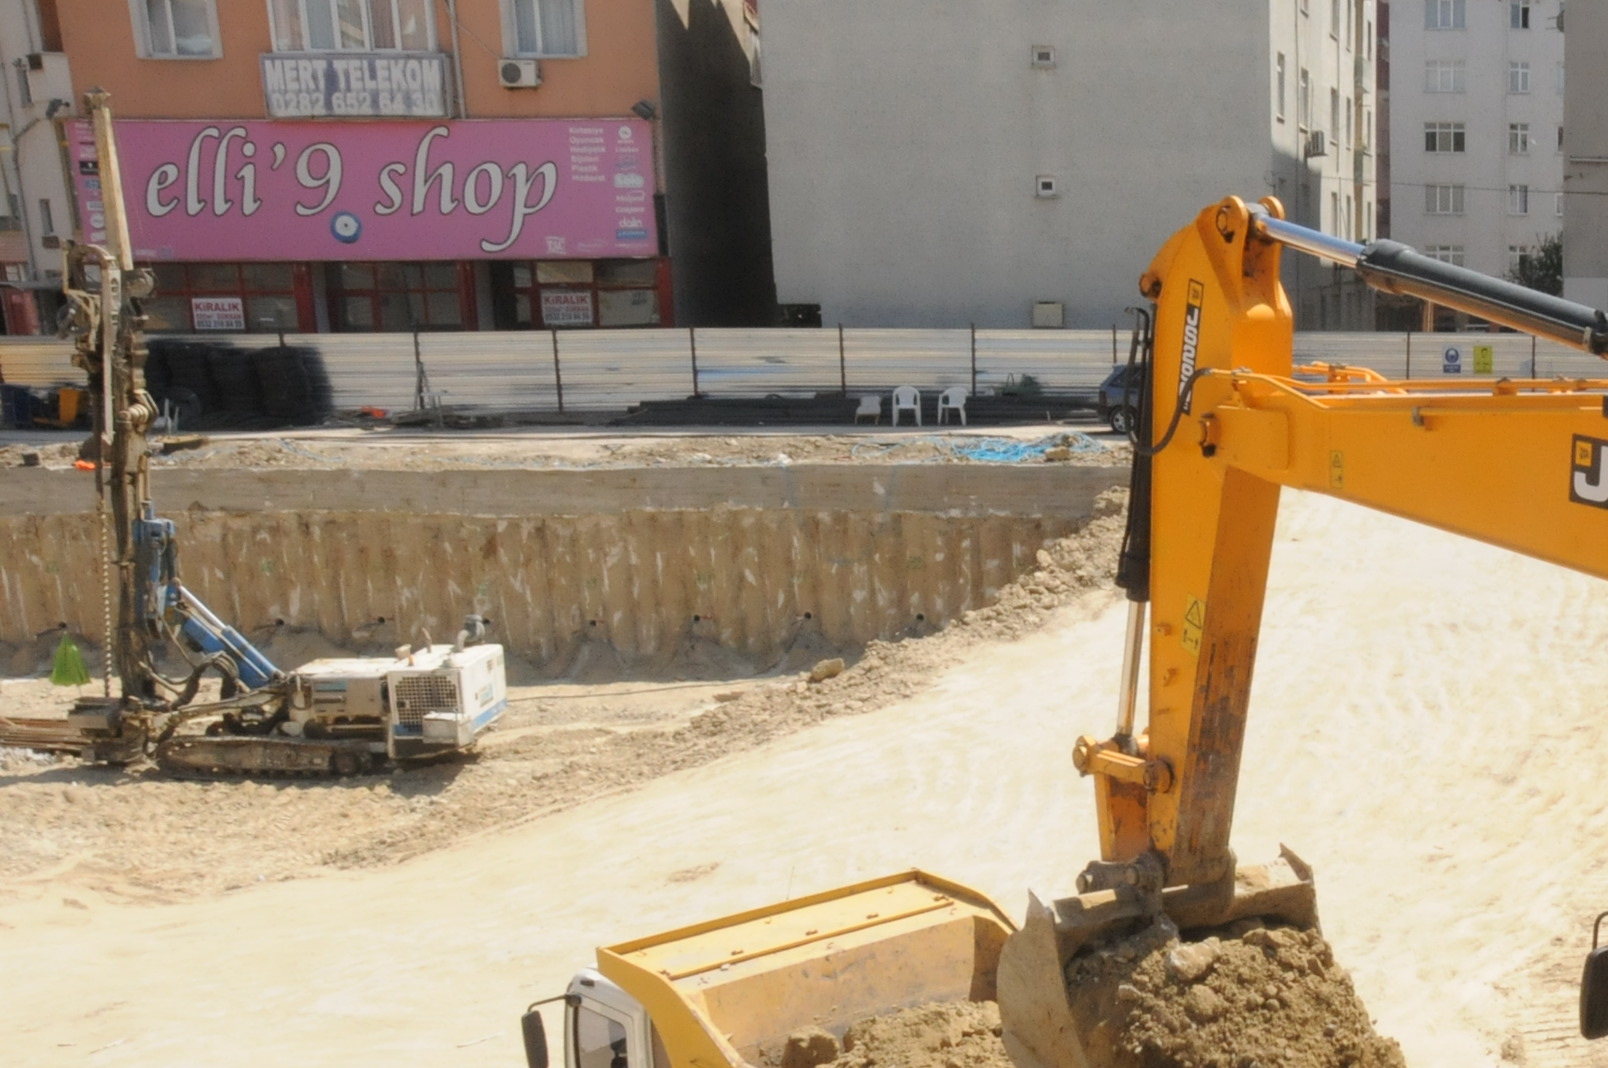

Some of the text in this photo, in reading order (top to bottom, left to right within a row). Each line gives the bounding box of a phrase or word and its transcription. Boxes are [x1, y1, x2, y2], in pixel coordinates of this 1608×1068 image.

[264, 59, 441, 90] MERT TELEKOM
[373, 126, 558, 253] shop
